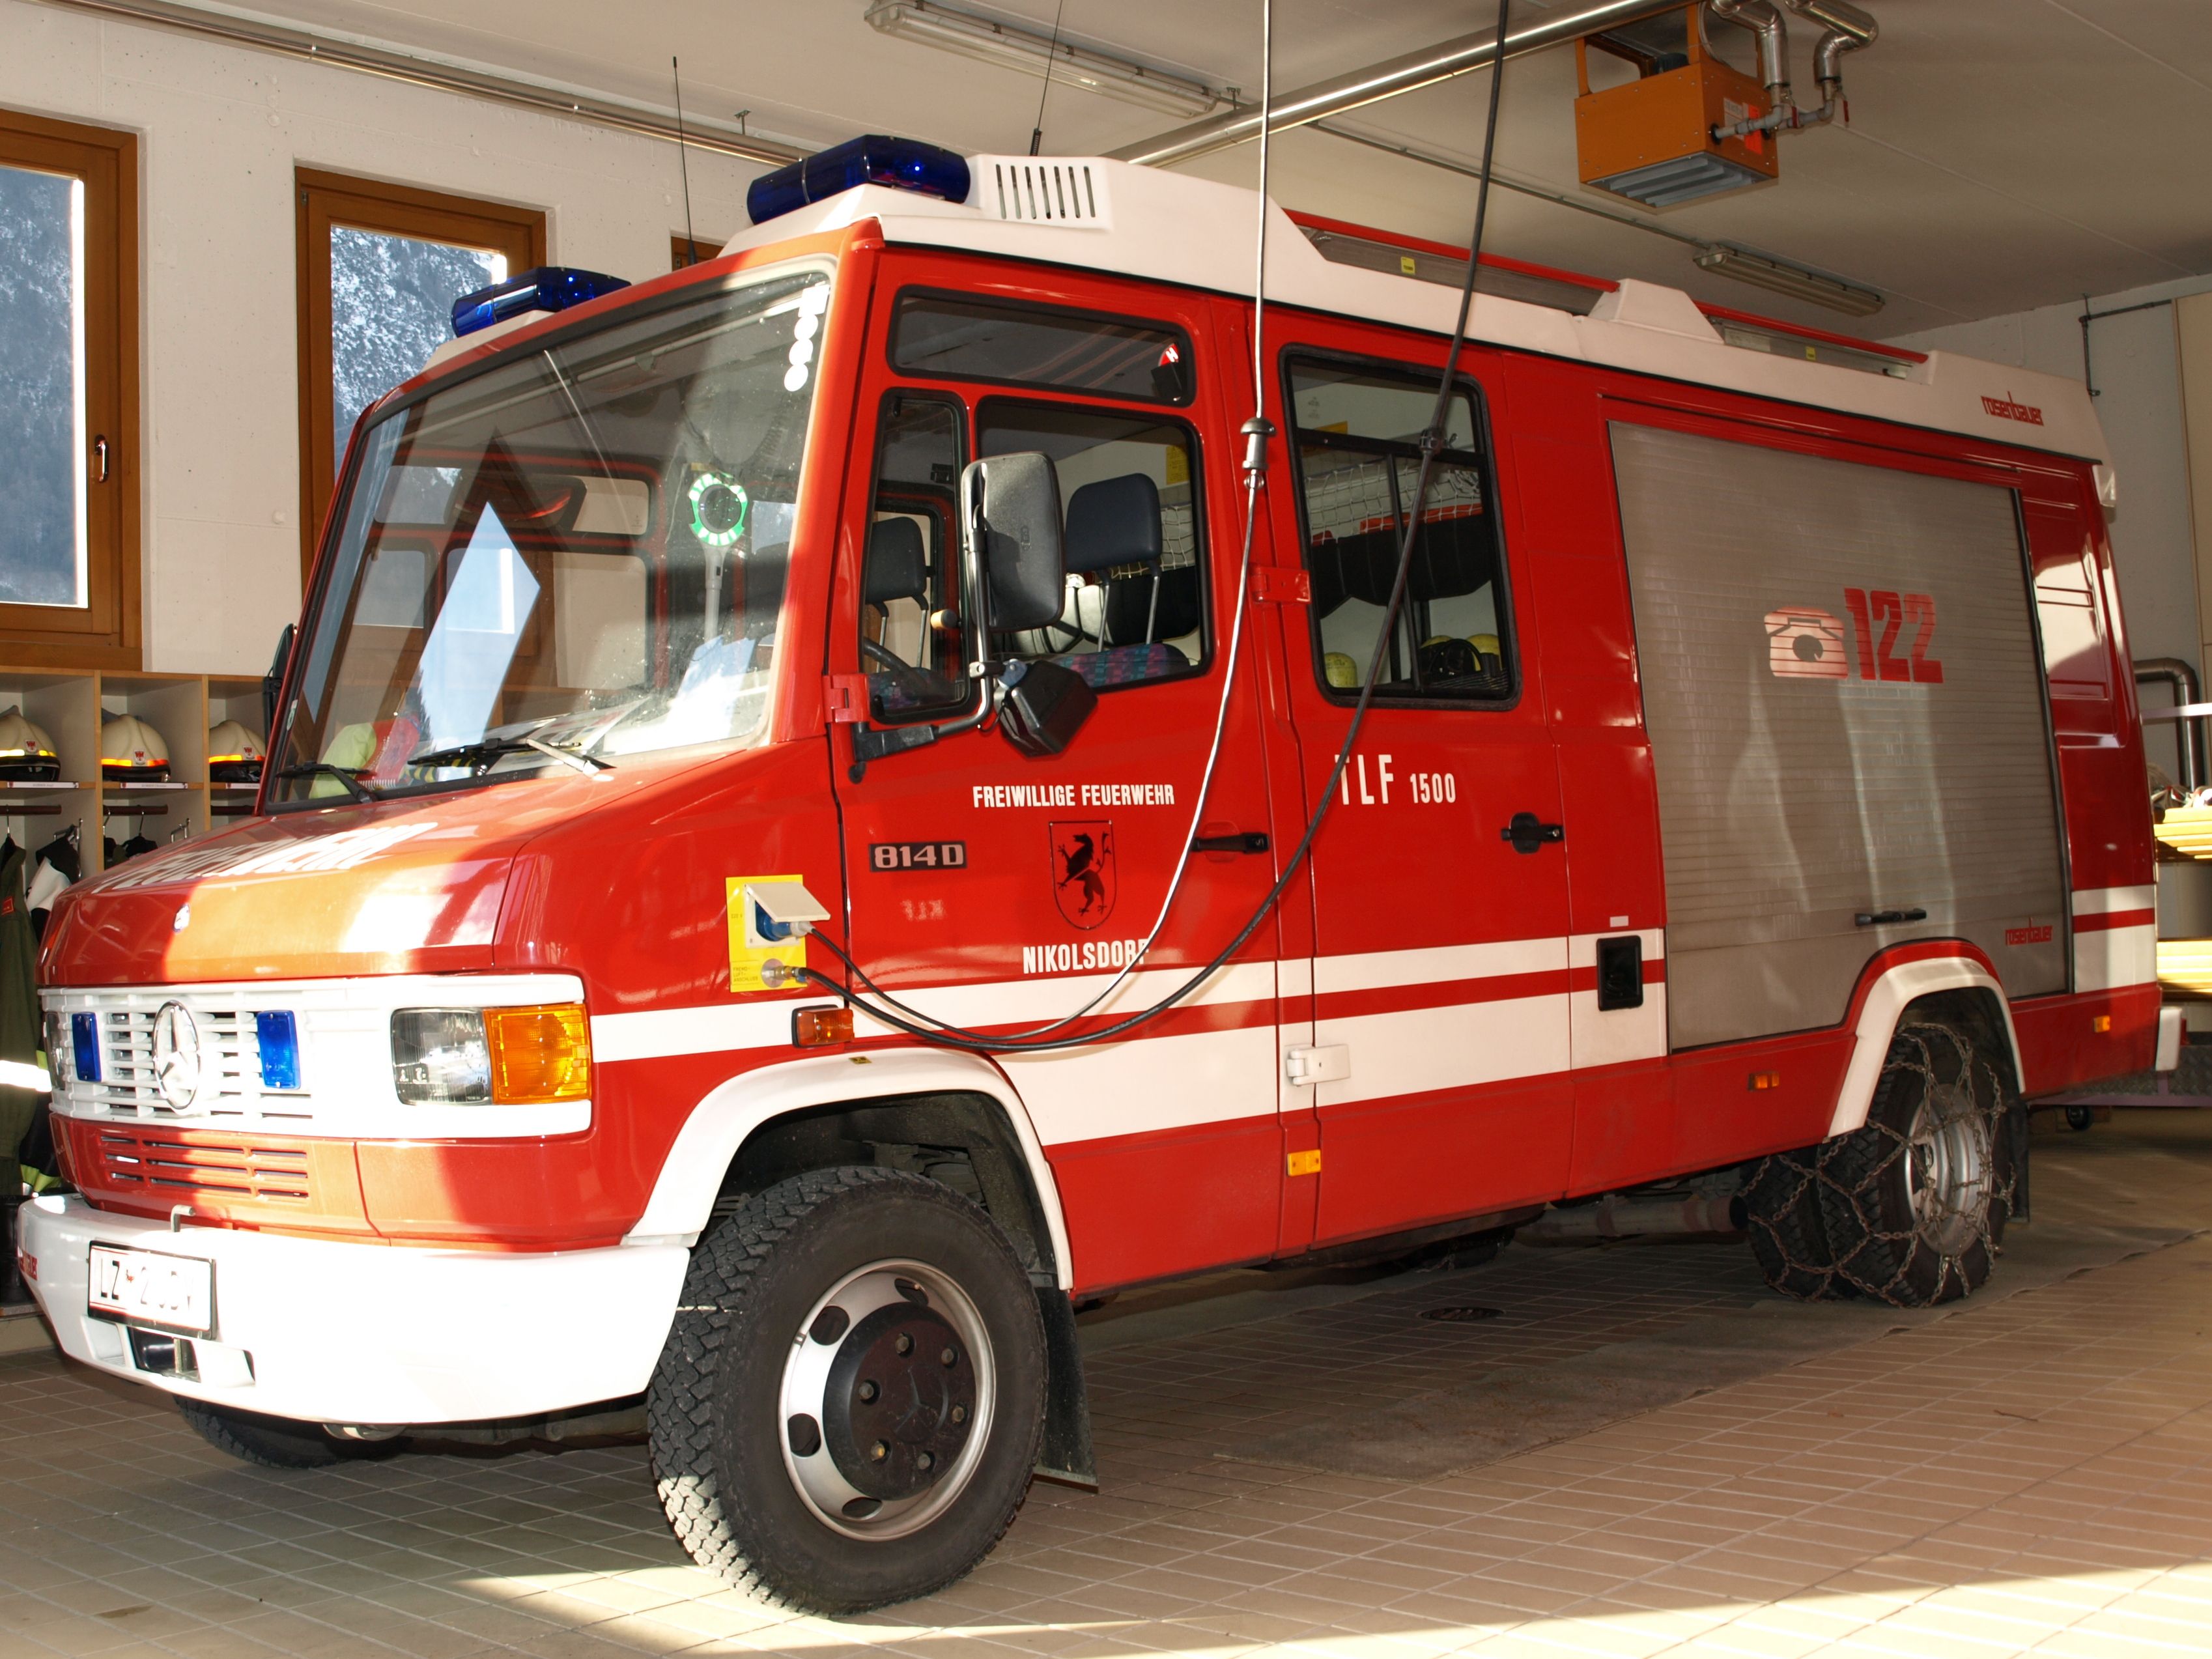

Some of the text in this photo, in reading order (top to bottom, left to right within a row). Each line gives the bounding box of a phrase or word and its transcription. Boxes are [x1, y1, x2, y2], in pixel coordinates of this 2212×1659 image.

[1981, 391, 2044, 426] rosenbauer
[1844, 588, 1944, 683] 122
[972, 784, 1175, 808] FREIWILLIGE FEUERWEHR
[1334, 754, 1456, 805] TLF 1500
[2005, 917, 2053, 946] rosenbauer
